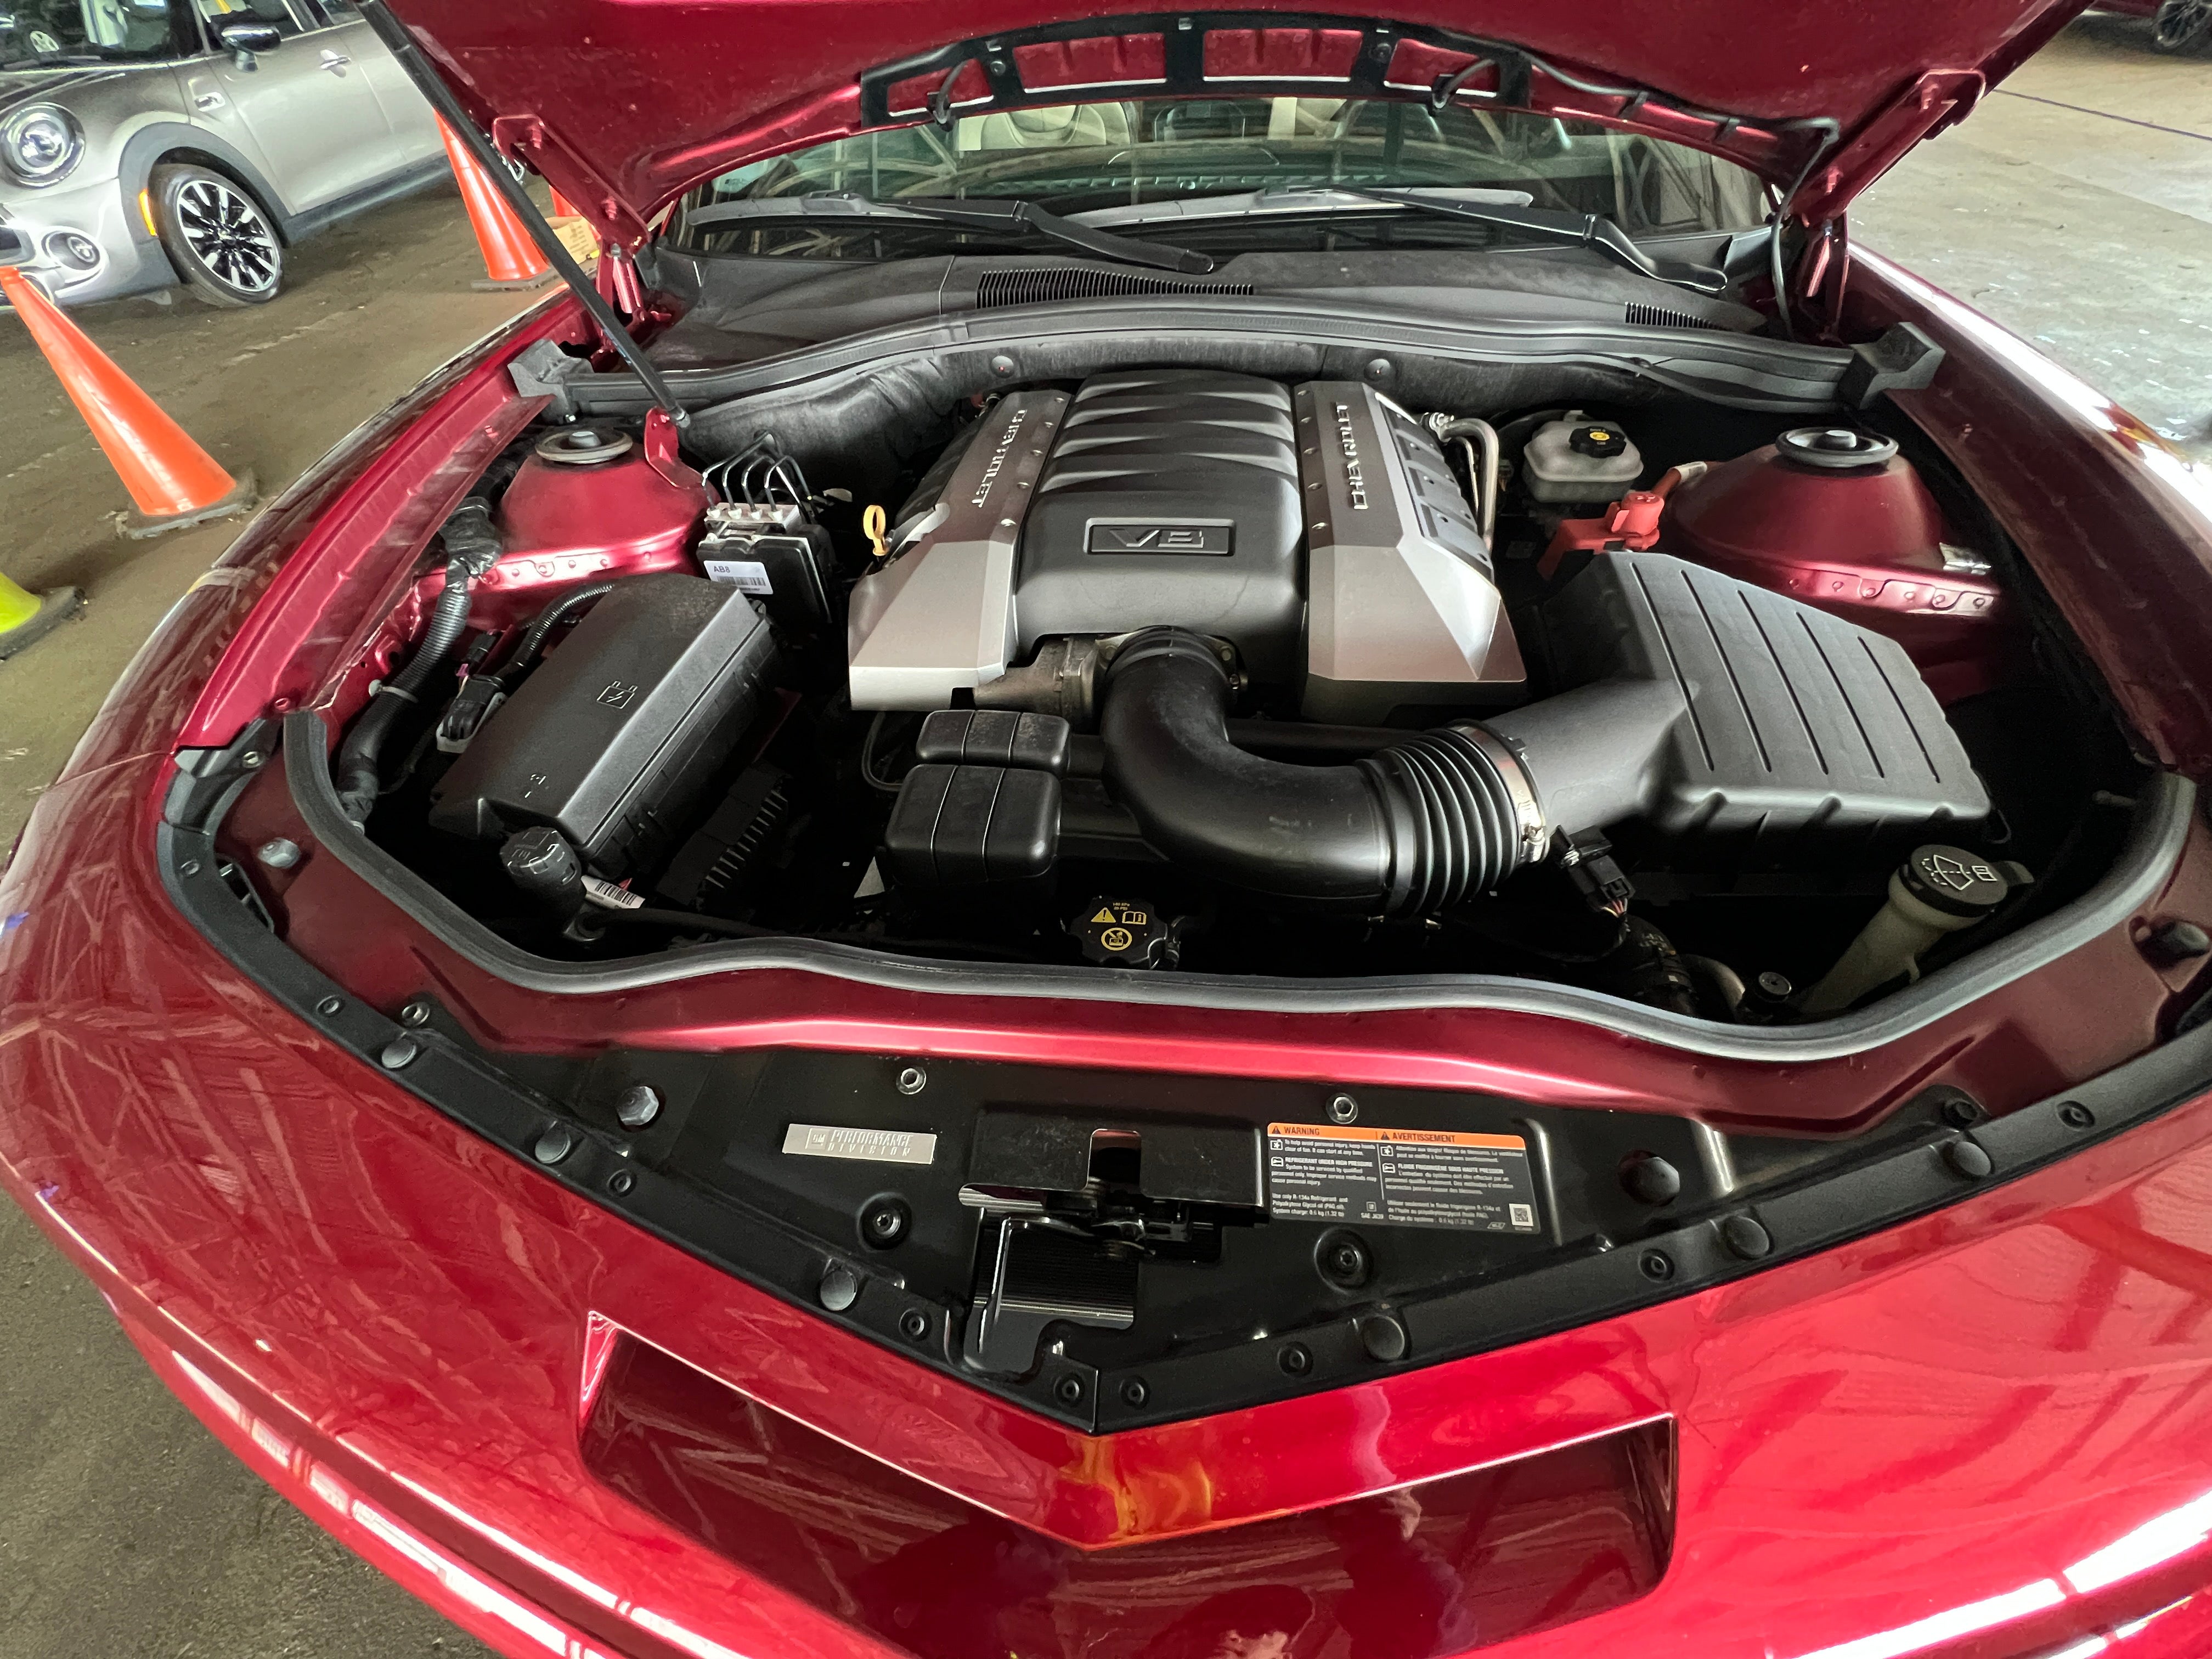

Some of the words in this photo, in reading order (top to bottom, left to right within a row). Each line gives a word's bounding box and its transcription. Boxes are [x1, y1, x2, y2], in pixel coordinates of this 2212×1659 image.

[972, 409, 1028, 508] CHEVROLET
[1335, 402, 1369, 510] CHEVROLET
[1109, 528, 1204, 549] V8
[830, 1129, 913, 1147] PERFORMANCE
[1284, 1126, 1320, 1136] WARNING
[1392, 1132, 1456, 1143] AVERTISSEMENT
[827, 1142, 910, 1156] DIVISION
